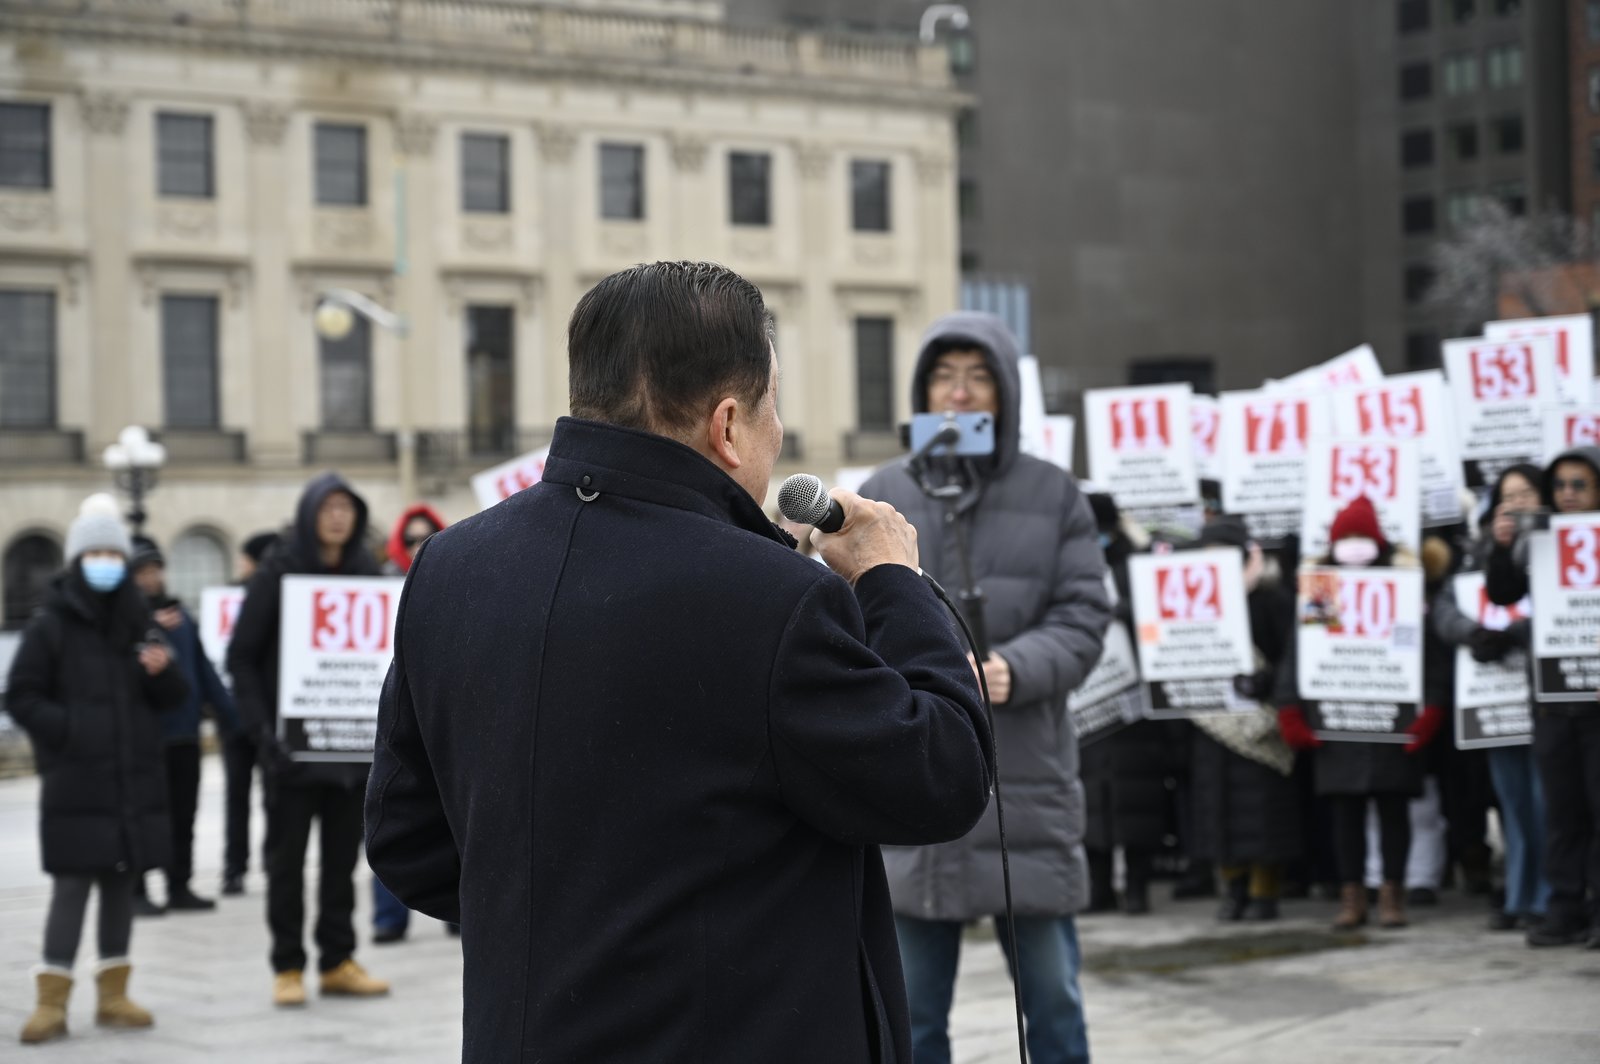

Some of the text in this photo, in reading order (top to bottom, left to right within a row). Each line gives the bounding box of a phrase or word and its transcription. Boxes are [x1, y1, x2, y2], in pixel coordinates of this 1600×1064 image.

[1470, 344, 1535, 398] 53
[1111, 398, 1170, 449] 11
[1245, 400, 1309, 453] 71
[1356, 386, 1425, 437] 15
[1331, 445, 1398, 500] 53
[1157, 564, 1222, 619] 42
[313, 590, 389, 651] 30
